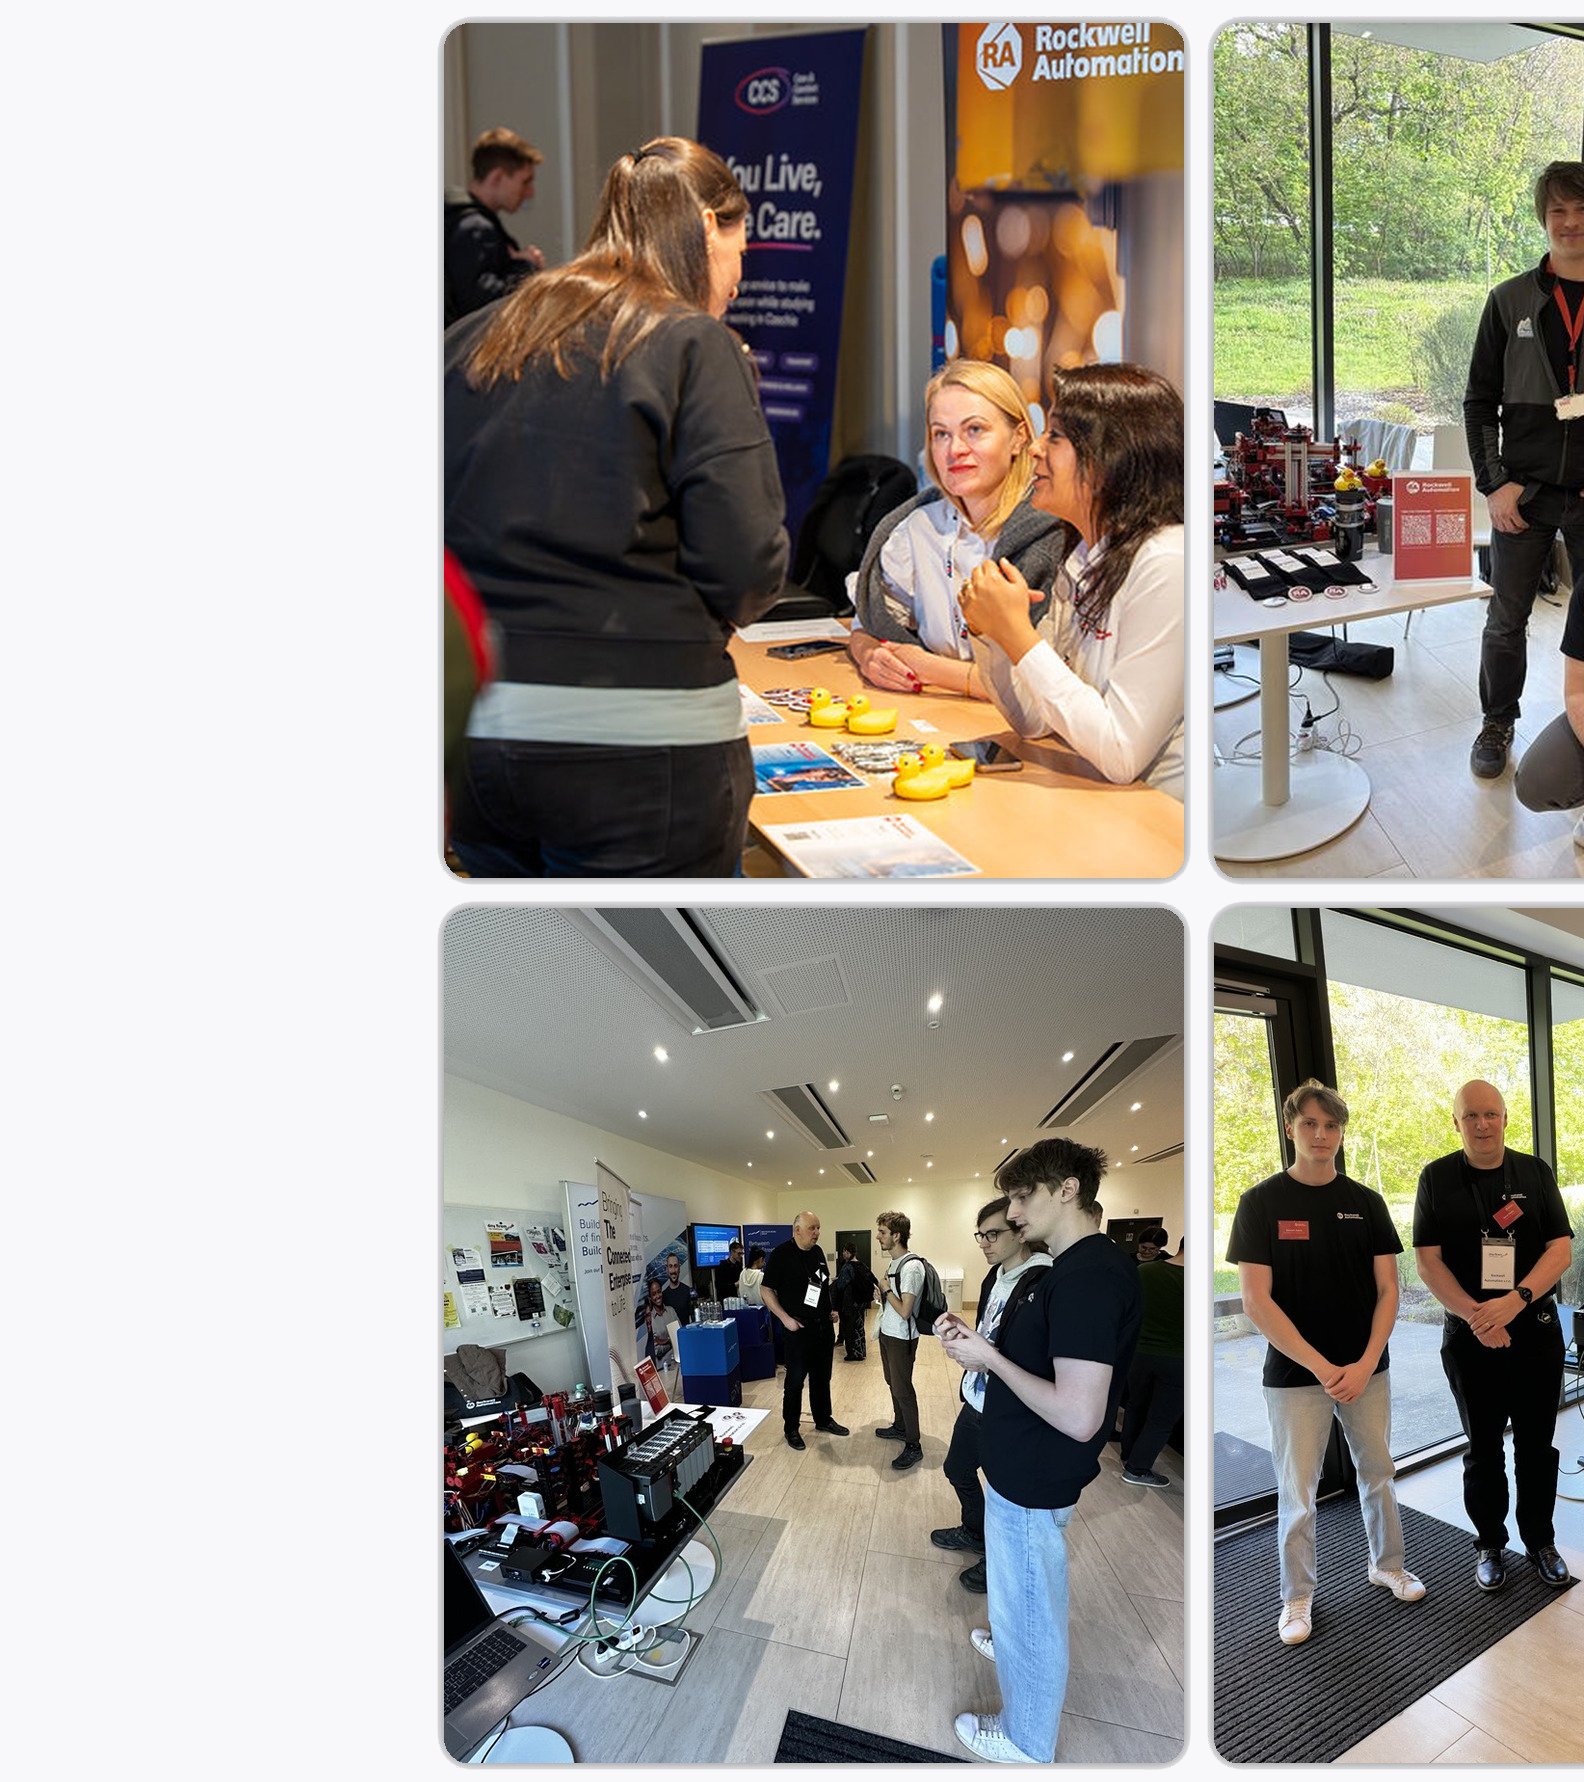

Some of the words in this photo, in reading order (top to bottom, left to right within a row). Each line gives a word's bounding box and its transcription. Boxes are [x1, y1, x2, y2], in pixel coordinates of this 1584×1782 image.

[1035, 23, 1150, 51] Rockwell
[1032, 46, 1184, 81] Automation
[748, 78, 780, 105] CCS
[764, 153, 822, 198] Live,
[757, 202, 822, 239] Care.
[604, 1219, 616, 1239] The
